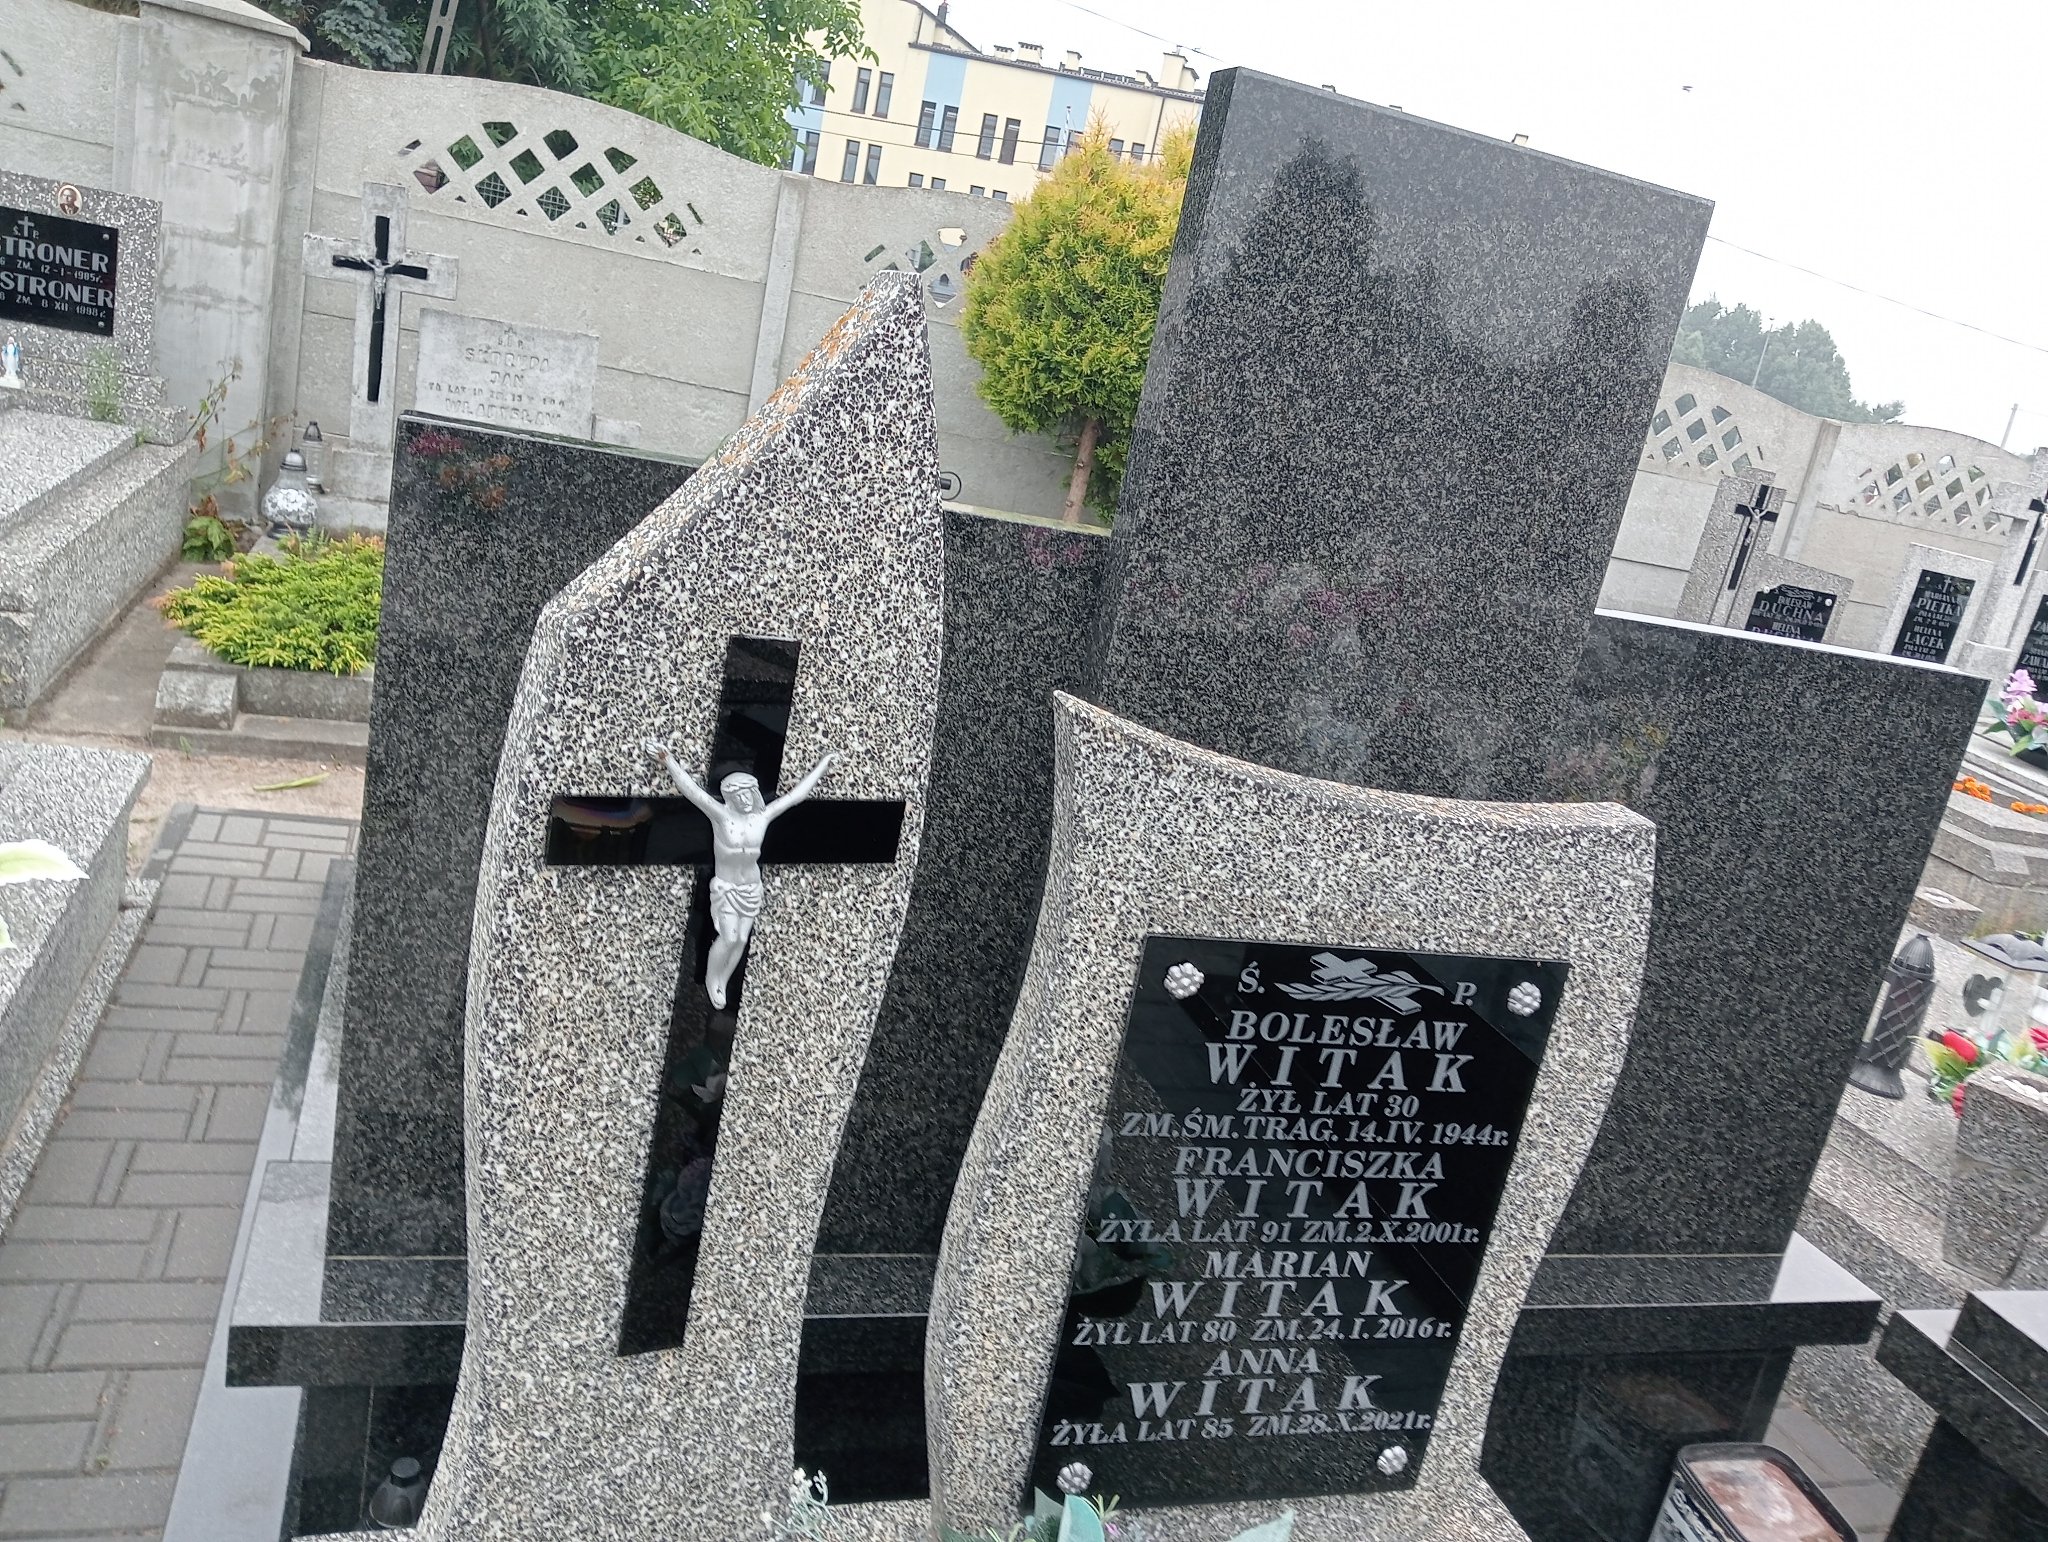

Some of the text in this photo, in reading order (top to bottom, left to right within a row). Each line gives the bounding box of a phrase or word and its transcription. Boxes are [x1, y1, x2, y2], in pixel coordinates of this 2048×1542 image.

[0, 235, 109, 273] TRONER
[0, 271, 114, 308] STRONER
[490, 370, 524, 388] JAN
[1760, 600, 1824, 624] DUCHNA
[1450, 982, 1477, 1006] P.
[1225, 1009, 1467, 1050] BOLESŁAW
[1204, 1042, 1474, 1093] WITAK
[1235, 1081, 1420, 1118] ŻYŁ LAT 30
[1428, 1122, 1509, 1147] 1944r.
[1172, 1145, 1445, 1180] FRANCISZKA
[1173, 1178, 1438, 1219] WITAK
[1096, 1212, 1185, 1243] ŻYŁA
[1190, 1220, 1257, 1243] LAT
[1260, 1220, 1292, 1243] 91
[1202, 1250, 1375, 1280] MARIAN
[1148, 1279, 1410, 1320] WITAK
[1072, 1317, 1132, 1347] ŻYŁ
[1138, 1320, 1198, 1345] LAT
[1201, 1319, 1237, 1343] 80
[1203, 1347, 1321, 1377] ANNA
[1126, 1375, 1382, 1420] WITAK
[1049, 1418, 1129, 1447] ŻYŁA
[1138, 1418, 1197, 1442] LAT
[1201, 1416, 1235, 1440] 85
